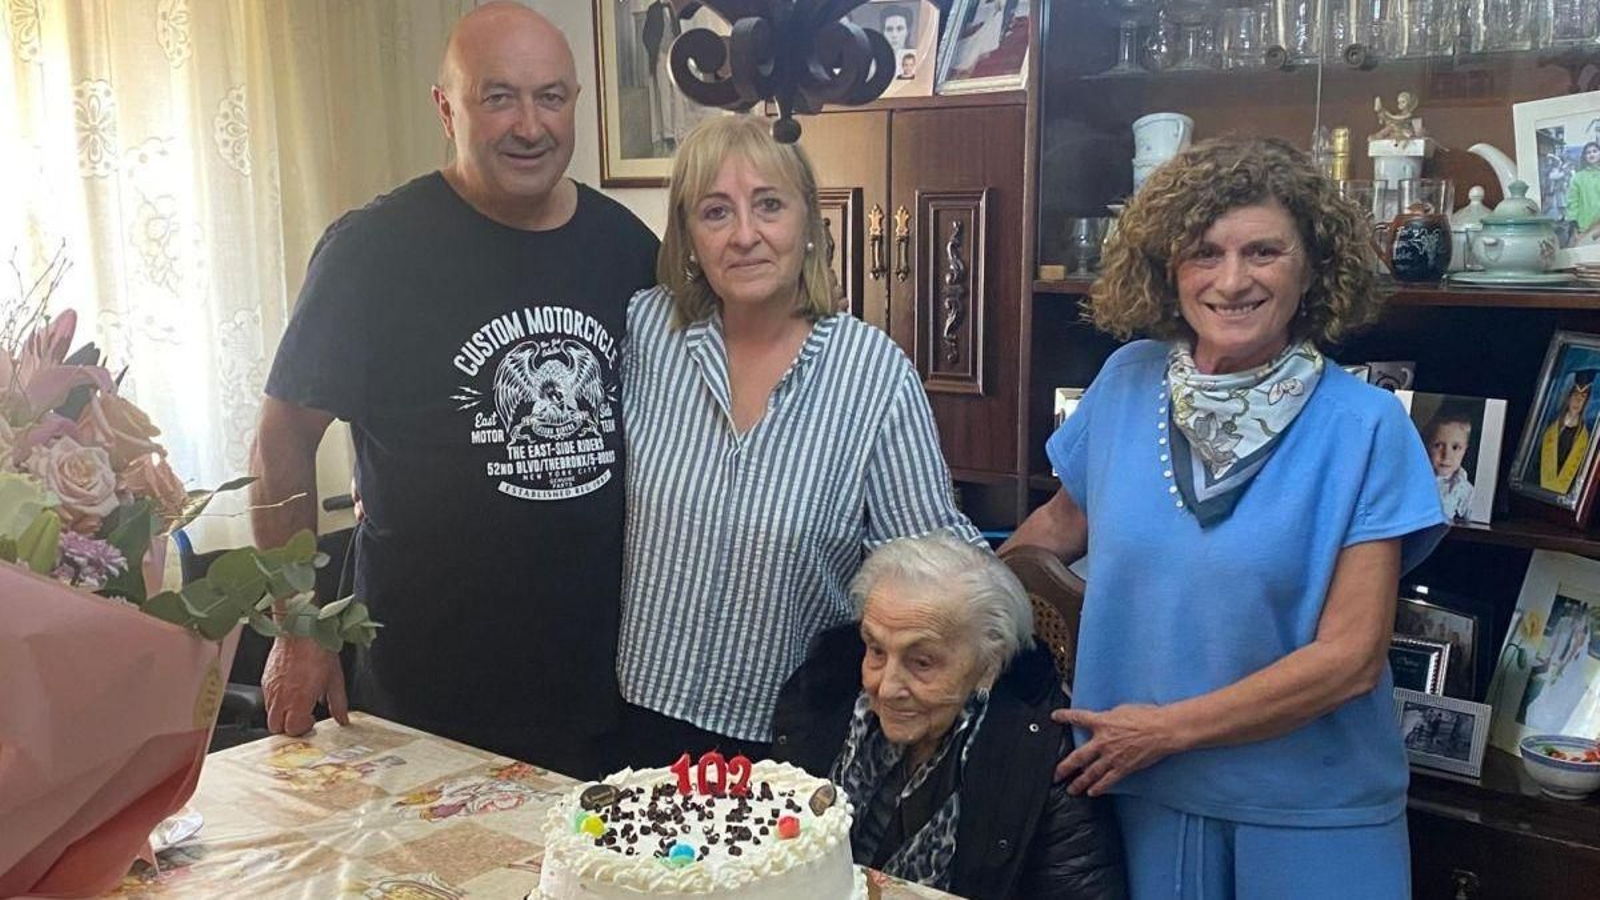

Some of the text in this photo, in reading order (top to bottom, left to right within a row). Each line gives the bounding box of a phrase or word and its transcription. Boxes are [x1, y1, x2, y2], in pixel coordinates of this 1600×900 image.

[453, 310, 525, 377] CUSTOM
[475, 411, 498, 428] East
[471, 429, 504, 444] MOTOR
[508, 445, 526, 460] THE
[527, 440, 576, 458] EAST-SIDE
[487, 462, 514, 476] 52ND
[505, 483, 572, 498] ESTABLISHED
[670, 751, 752, 797] 102
